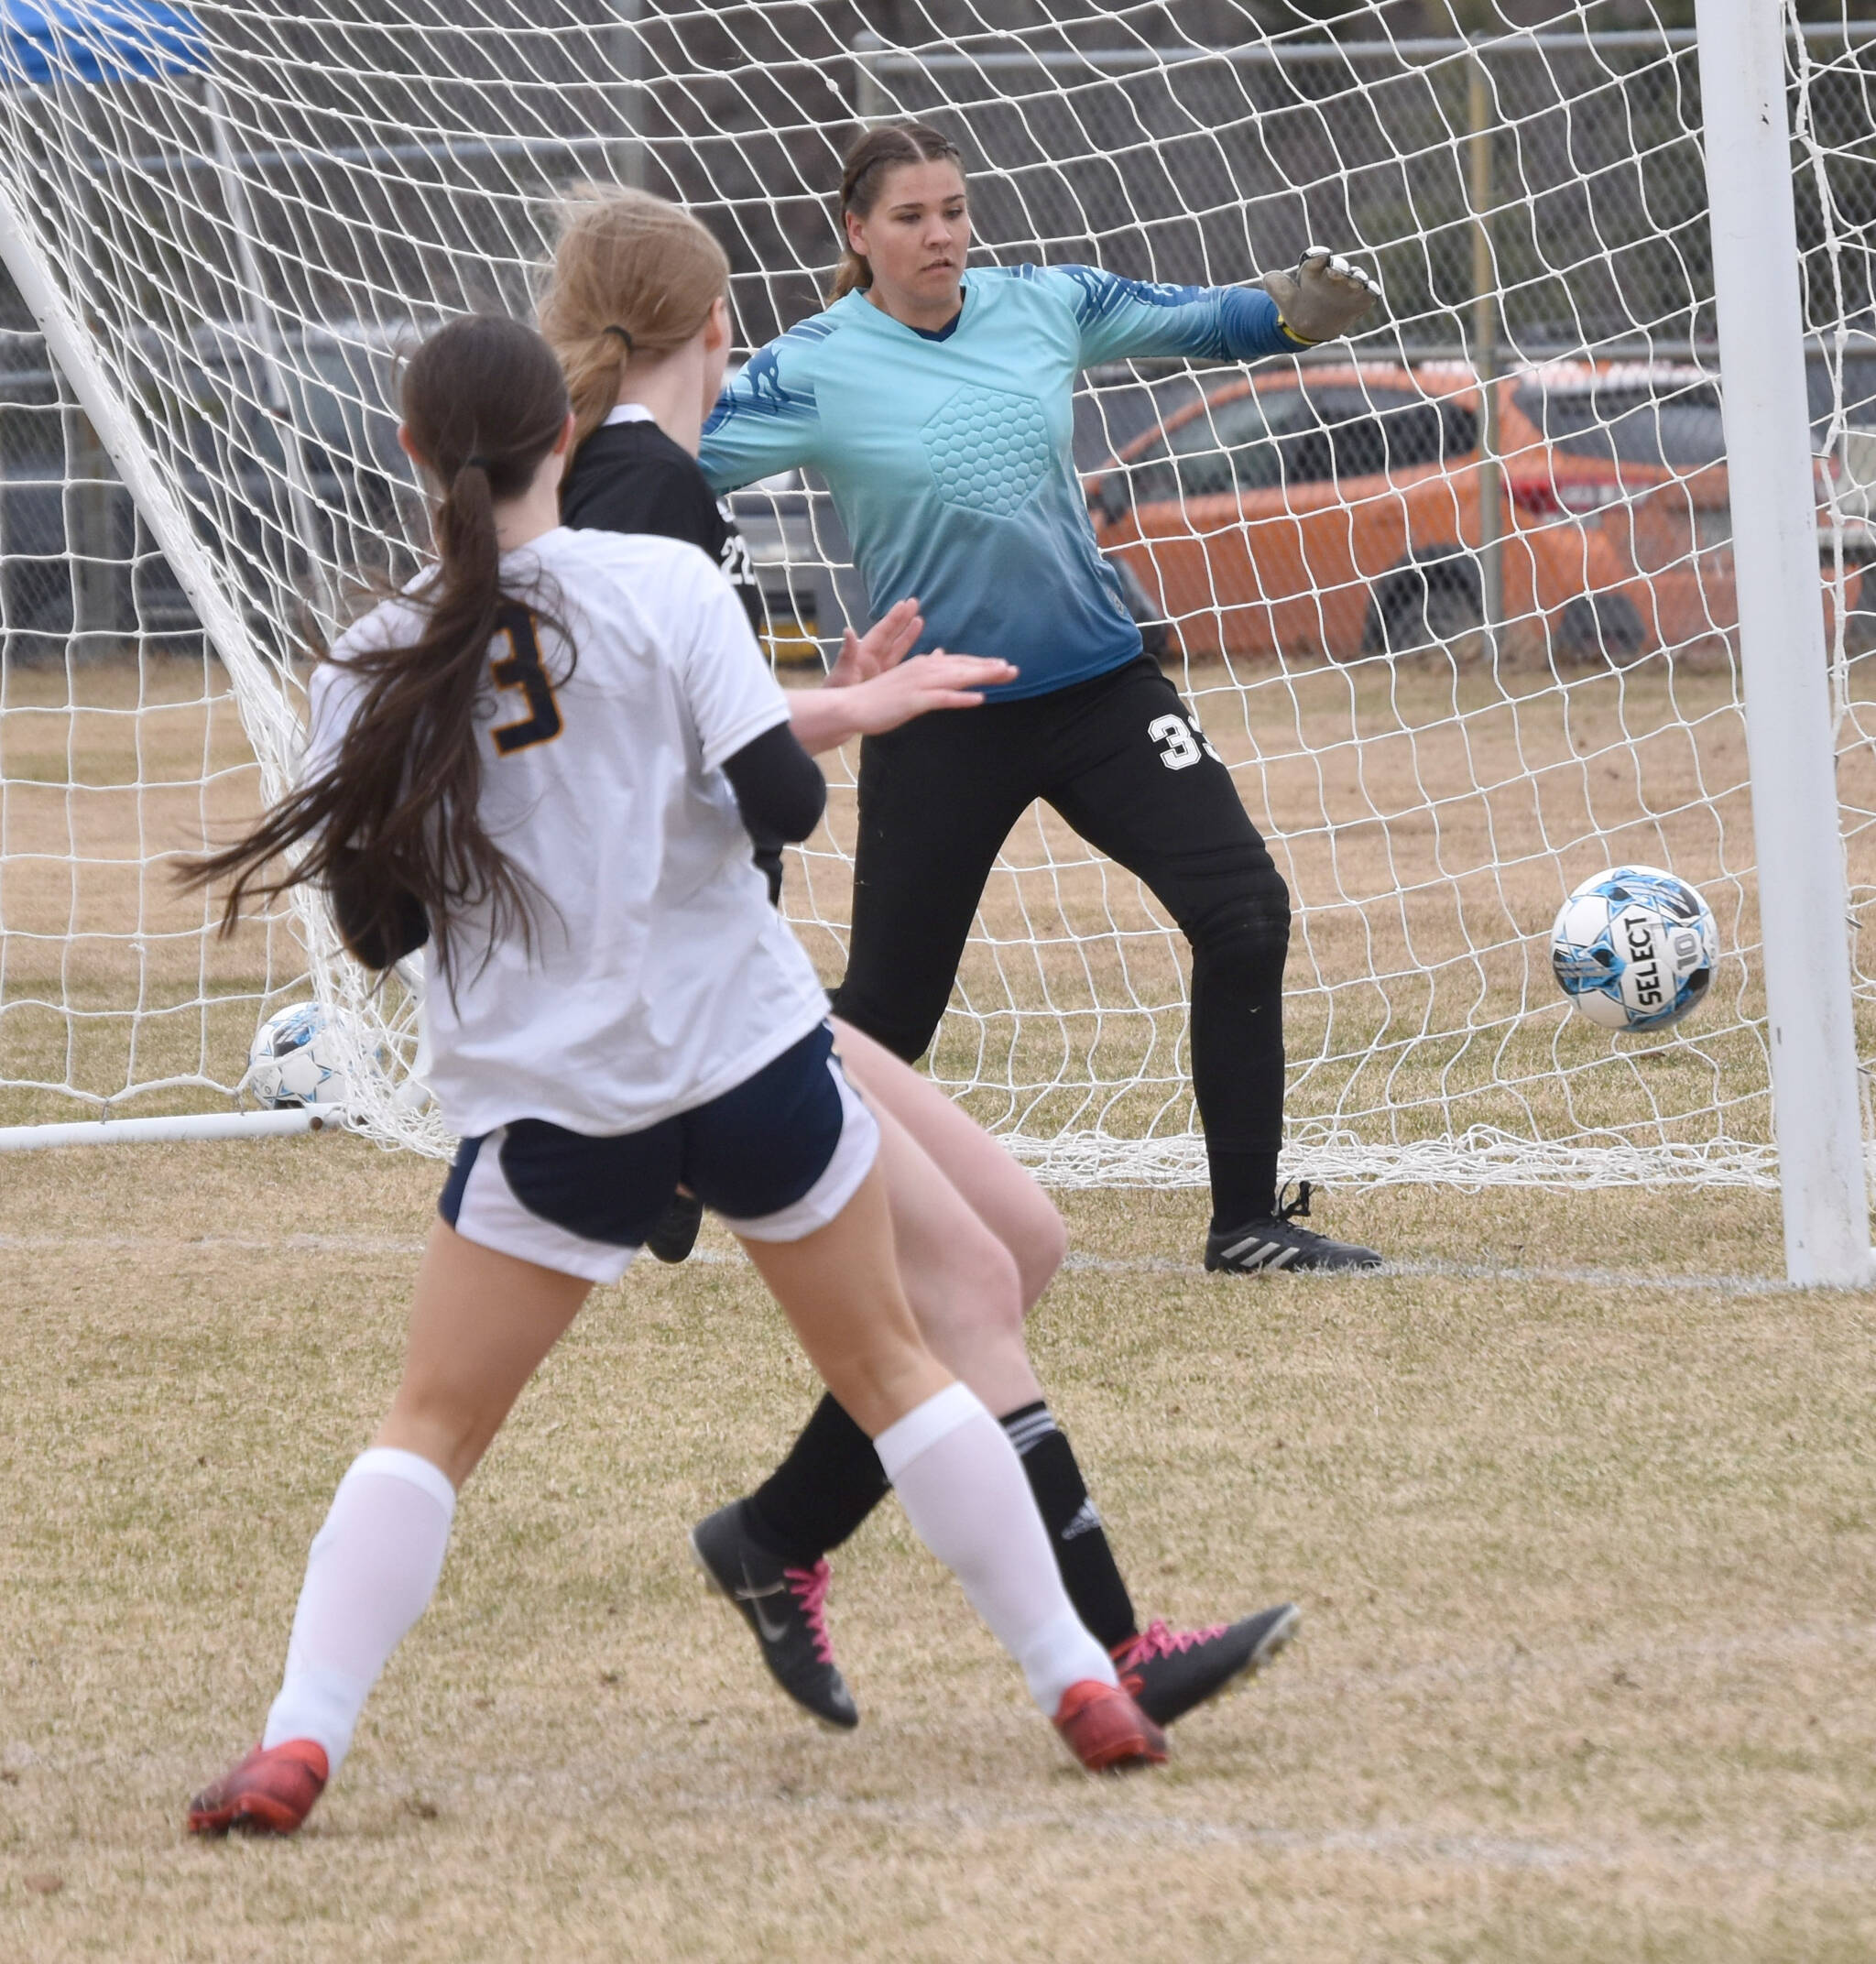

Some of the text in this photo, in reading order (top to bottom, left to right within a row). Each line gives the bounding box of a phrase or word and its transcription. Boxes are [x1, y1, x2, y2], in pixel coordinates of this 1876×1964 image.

[719, 535, 756, 584] 22
[487, 600, 565, 758] 3
[1148, 714, 1223, 770] 3
[1624, 917, 1663, 1006] SELECT
[1674, 933, 1697, 971] 10
